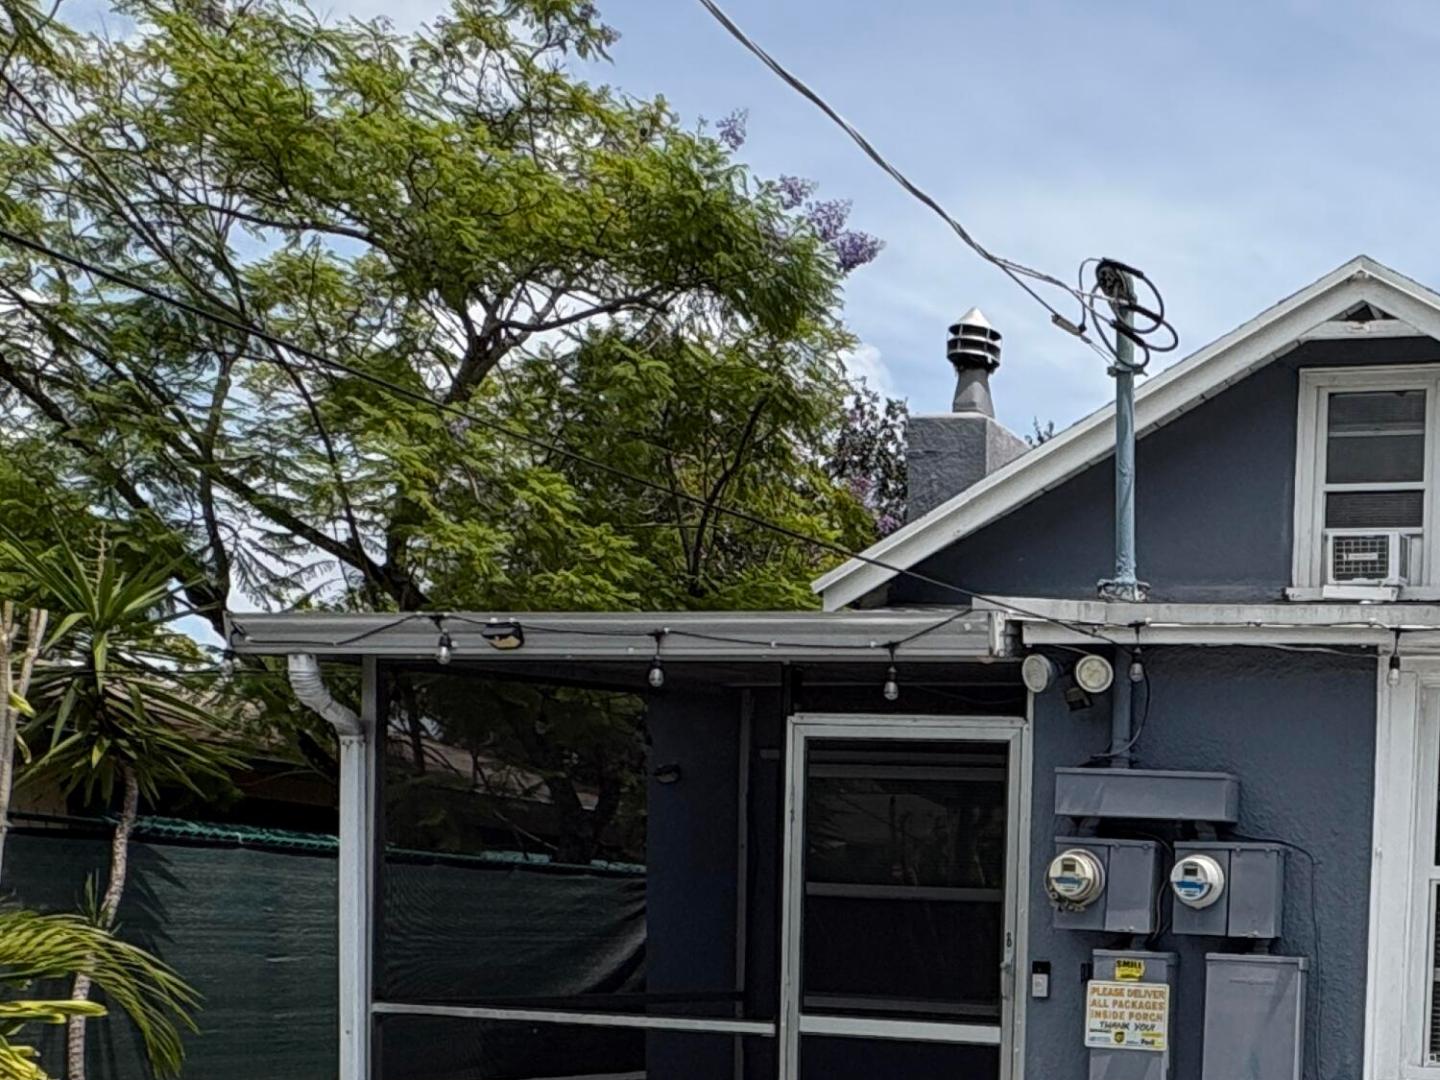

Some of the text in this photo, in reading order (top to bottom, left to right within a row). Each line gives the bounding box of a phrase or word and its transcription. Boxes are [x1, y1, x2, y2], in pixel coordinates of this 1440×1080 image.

[1091, 987, 1165, 999] PLEASE DELIVER
[1091, 999, 1165, 1010] ALL PACKAGES
[1090, 1009, 1163, 1021] INSIDE PORCH
[1100, 1021, 1130, 1031] THANK
